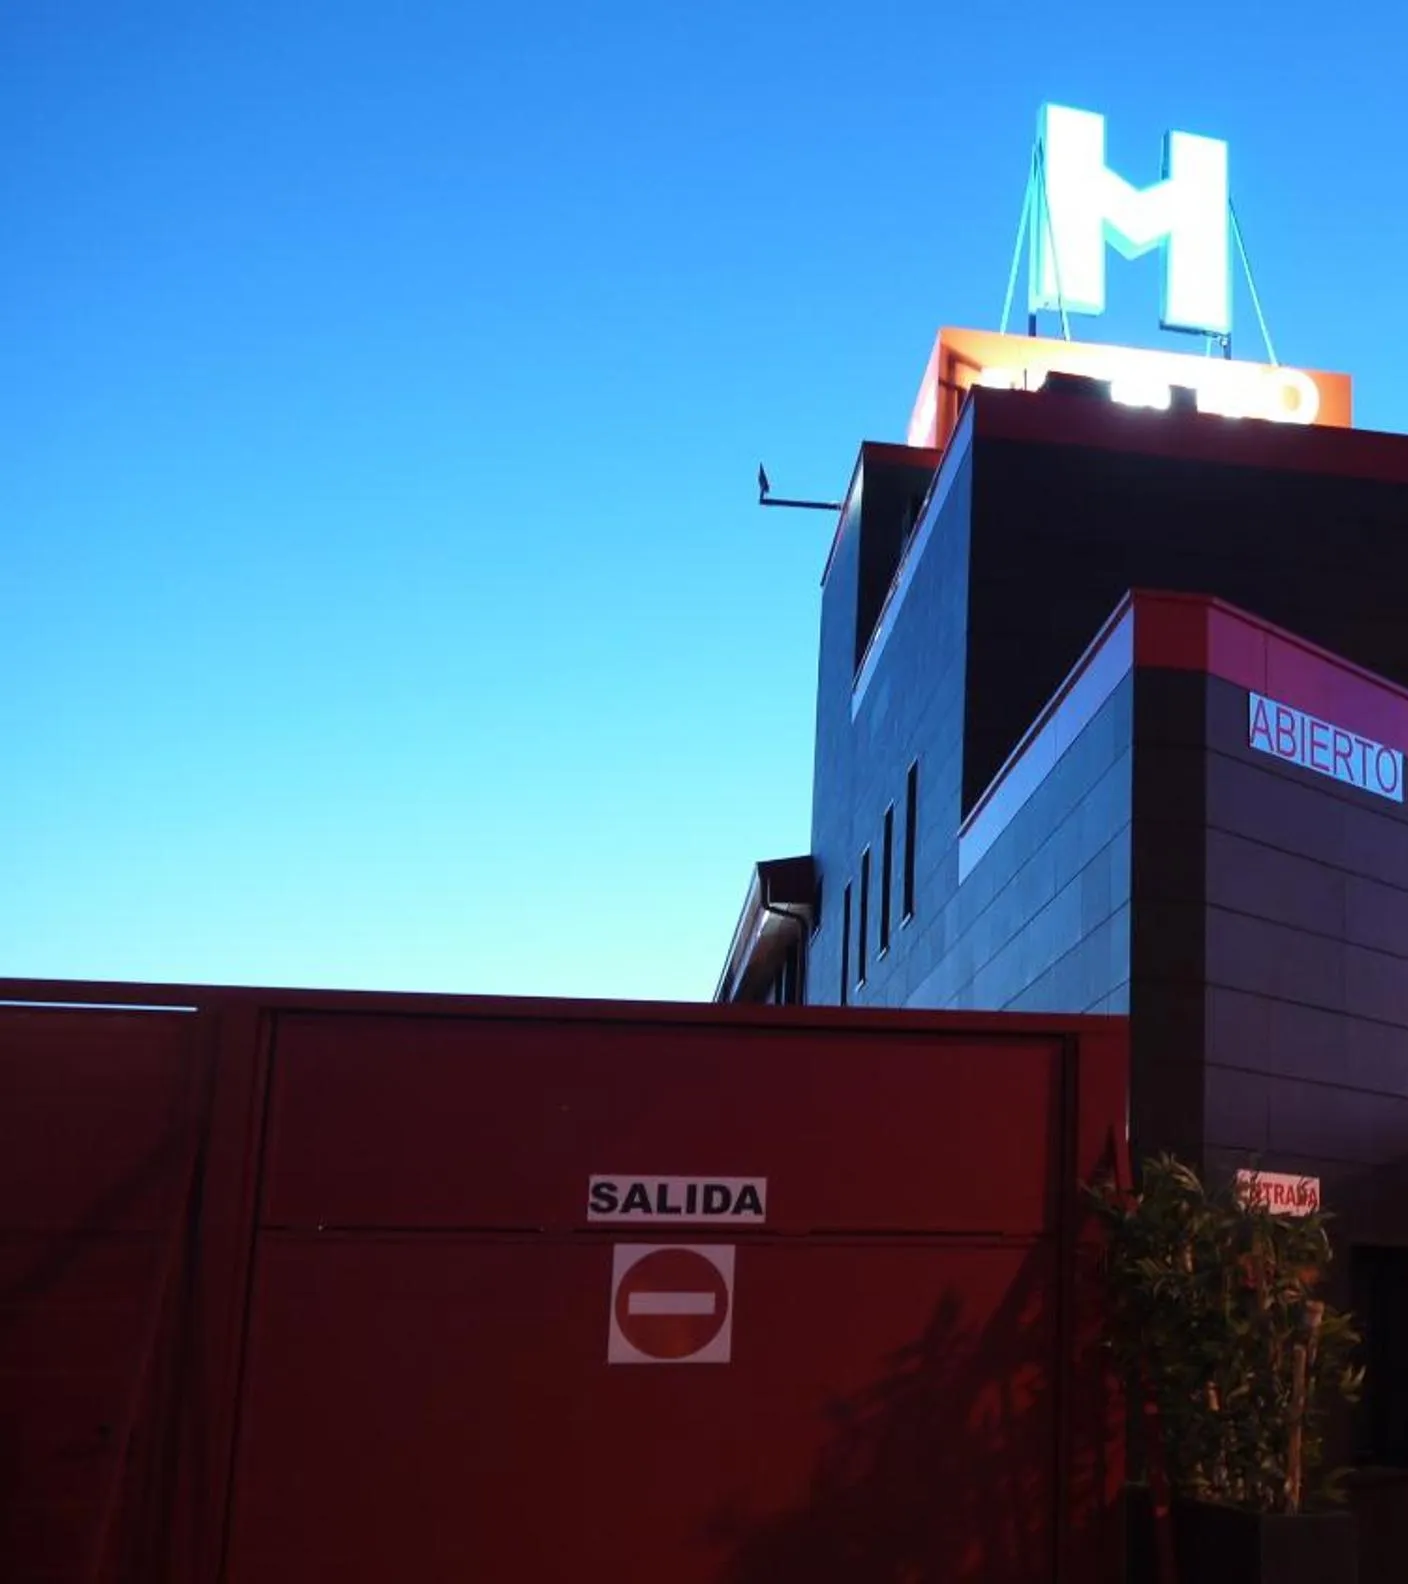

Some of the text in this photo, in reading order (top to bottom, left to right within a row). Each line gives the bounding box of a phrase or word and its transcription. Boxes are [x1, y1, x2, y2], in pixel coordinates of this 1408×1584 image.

[1251, 697, 1398, 793] ABIERTO
[590, 1182, 764, 1215] SALIDA
[1236, 1181, 1318, 1208] TRADA
